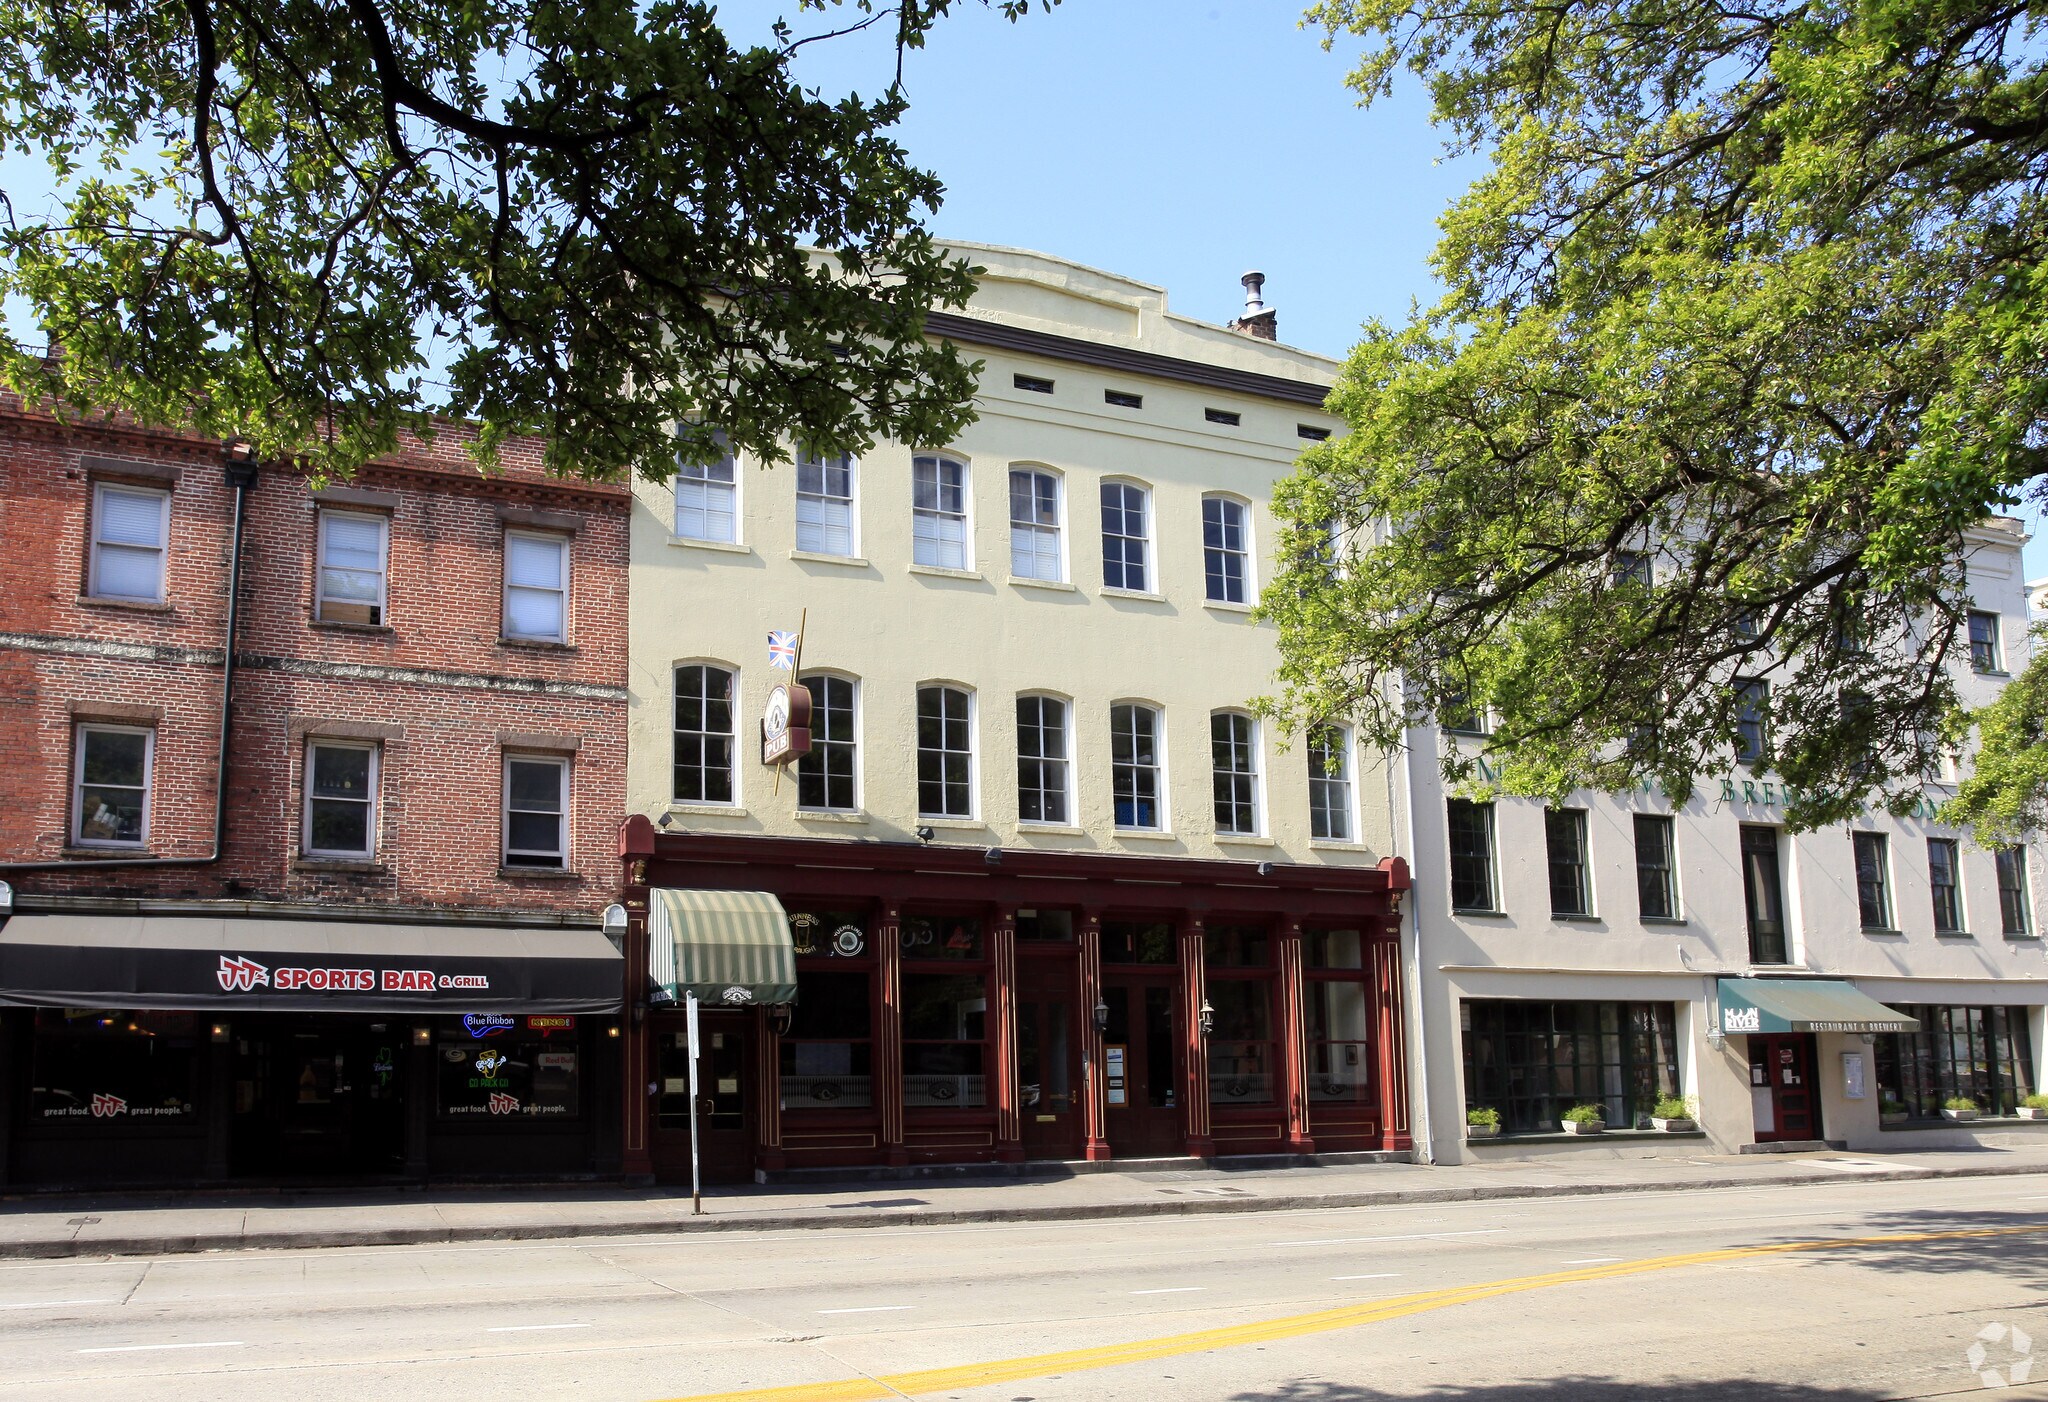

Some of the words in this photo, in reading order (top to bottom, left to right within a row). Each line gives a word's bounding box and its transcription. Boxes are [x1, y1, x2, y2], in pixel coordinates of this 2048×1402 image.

[766, 734, 787, 757] PUB
[788, 913, 820, 926] UINNESS
[833, 924, 863, 937] YUENGLING
[274, 967, 375, 991] SPORTS
[381, 969, 437, 992] BAR
[439, 975, 452, 989] &
[452, 975, 489, 989] GRILL
[467, 1016, 486, 1025] Blue
[486, 1016, 515, 1025] Ribbon
[1724, 1016, 1760, 1028] RIVER
[1809, 1022, 1858, 1032] RESTAURANT
[1869, 1022, 1903, 1032] BREWERY
[545, 1056, 560, 1064] Red
[469, 1078, 478, 1087] GO
[480, 1078, 498, 1087] PACK
[499, 1078, 509, 1087] GO
[44, 1107, 67, 1117] great
[68, 1106, 90, 1116] food.
[130, 1107, 153, 1116] great
[154, 1106, 182, 1116] people.
[449, 1105, 469, 1114] great
[470, 1104, 488, 1113] food.
[522, 1105, 541, 1114] great
[542, 1104, 566, 1113] people.
